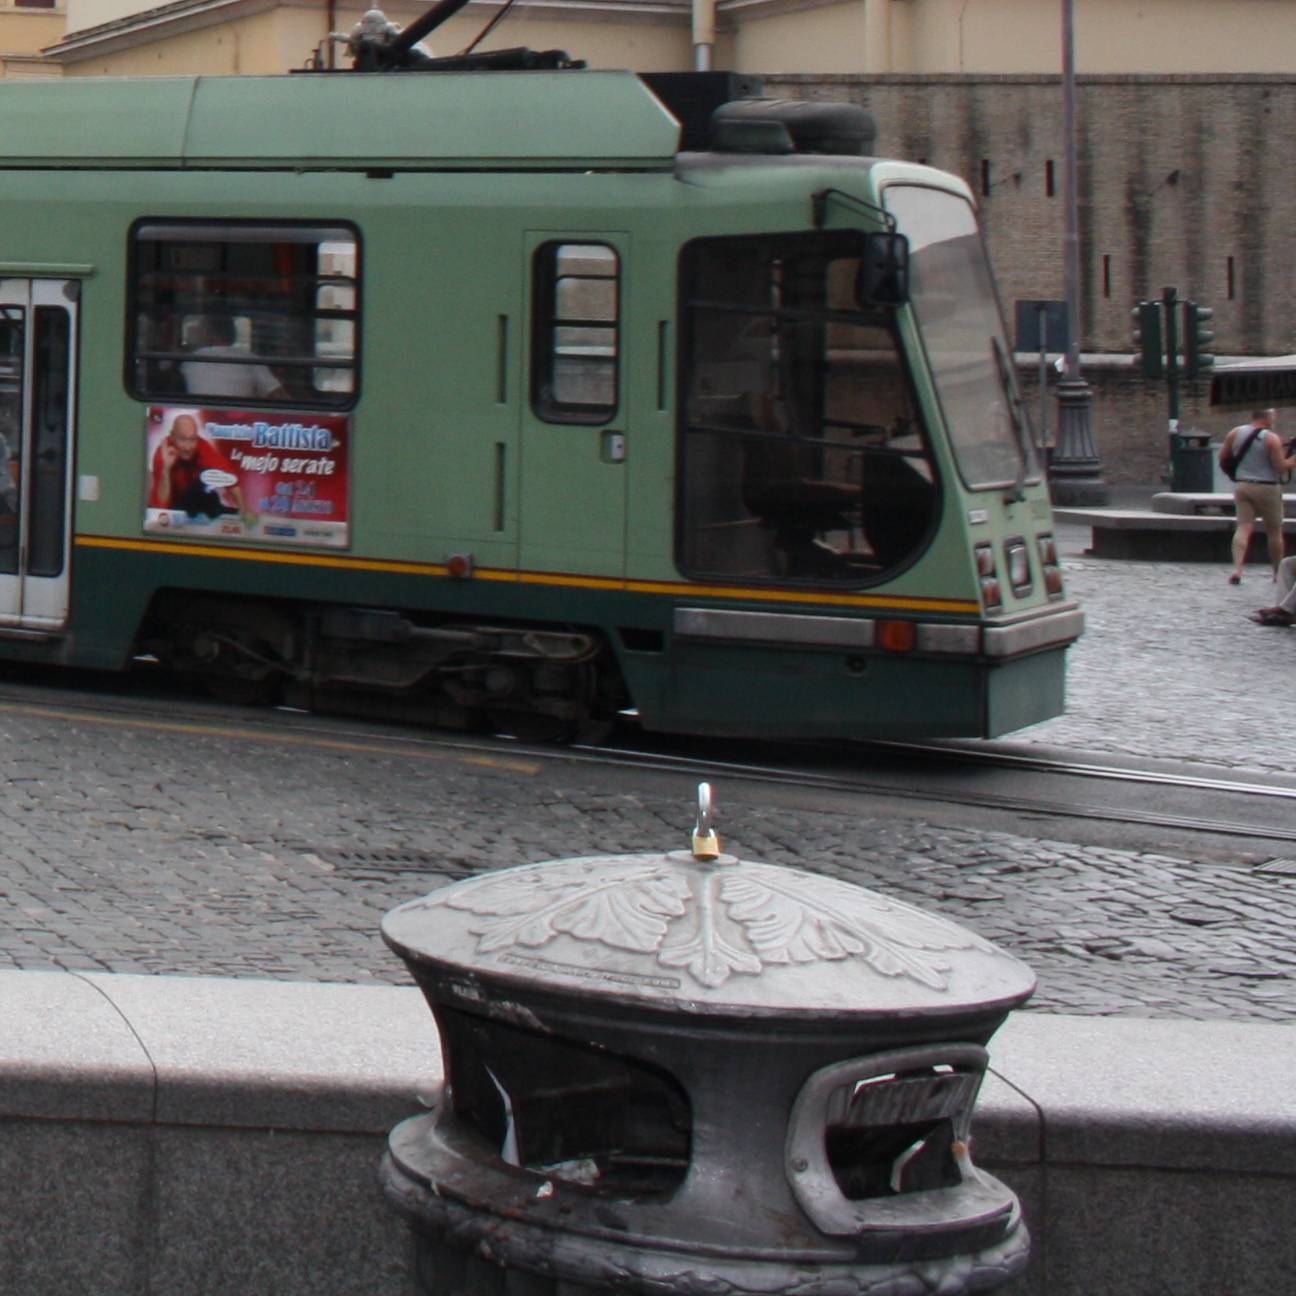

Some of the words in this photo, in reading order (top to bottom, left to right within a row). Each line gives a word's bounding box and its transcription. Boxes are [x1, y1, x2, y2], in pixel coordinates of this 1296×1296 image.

[252, 422, 333, 452] Battista
[240, 453, 278, 474] mejo
[281, 457, 335, 475] serate
